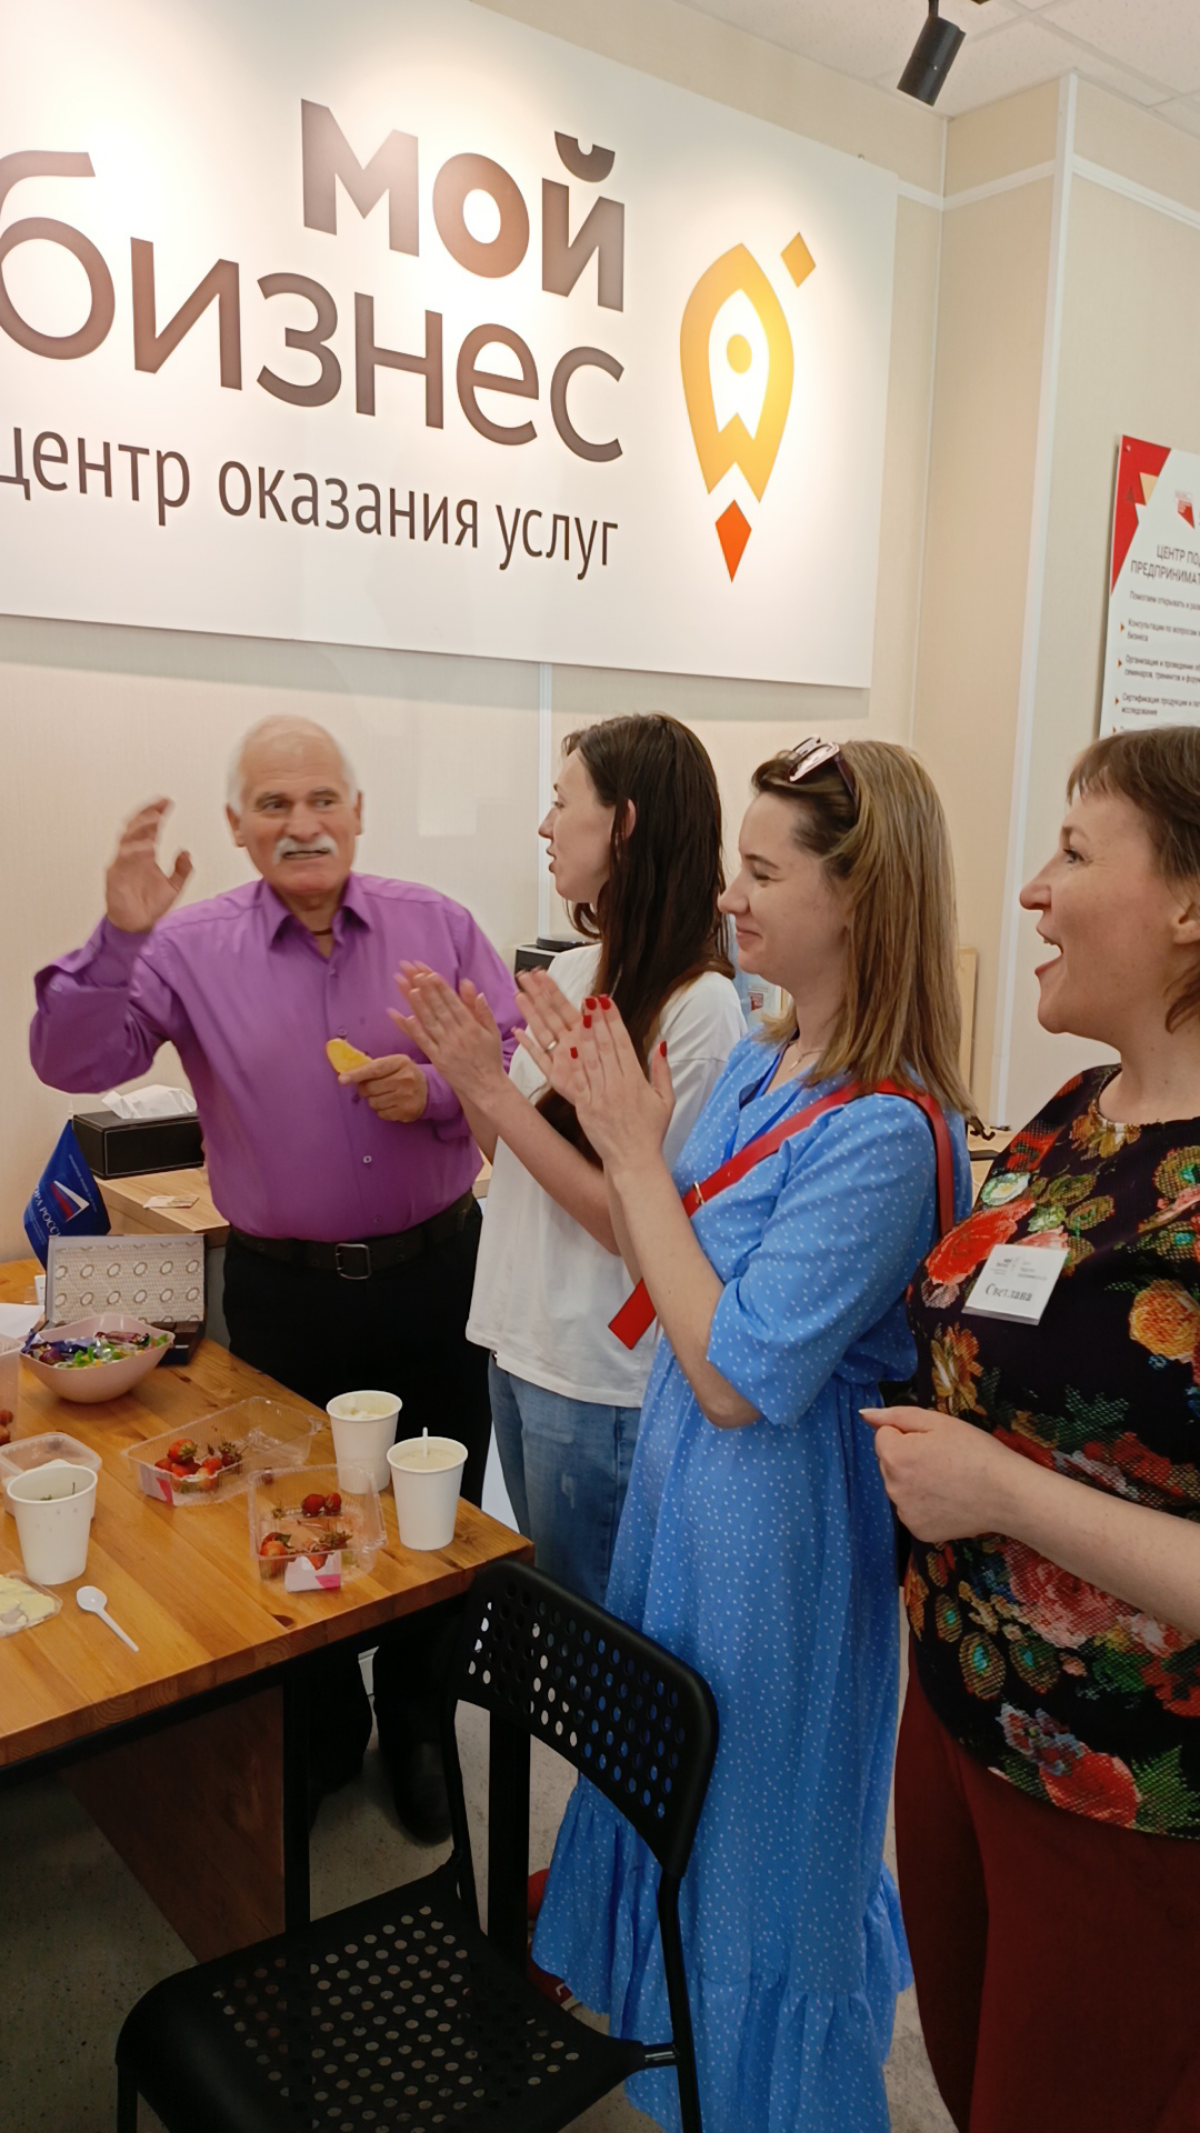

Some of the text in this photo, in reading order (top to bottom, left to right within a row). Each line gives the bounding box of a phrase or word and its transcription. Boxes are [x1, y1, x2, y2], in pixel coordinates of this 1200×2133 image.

[301, 98, 625, 313] мой
[0, 150, 625, 462] бизнес
[0, 427, 619, 580] центр оказания услуг
[1156, 545, 1186, 562] ЦЕНТР
